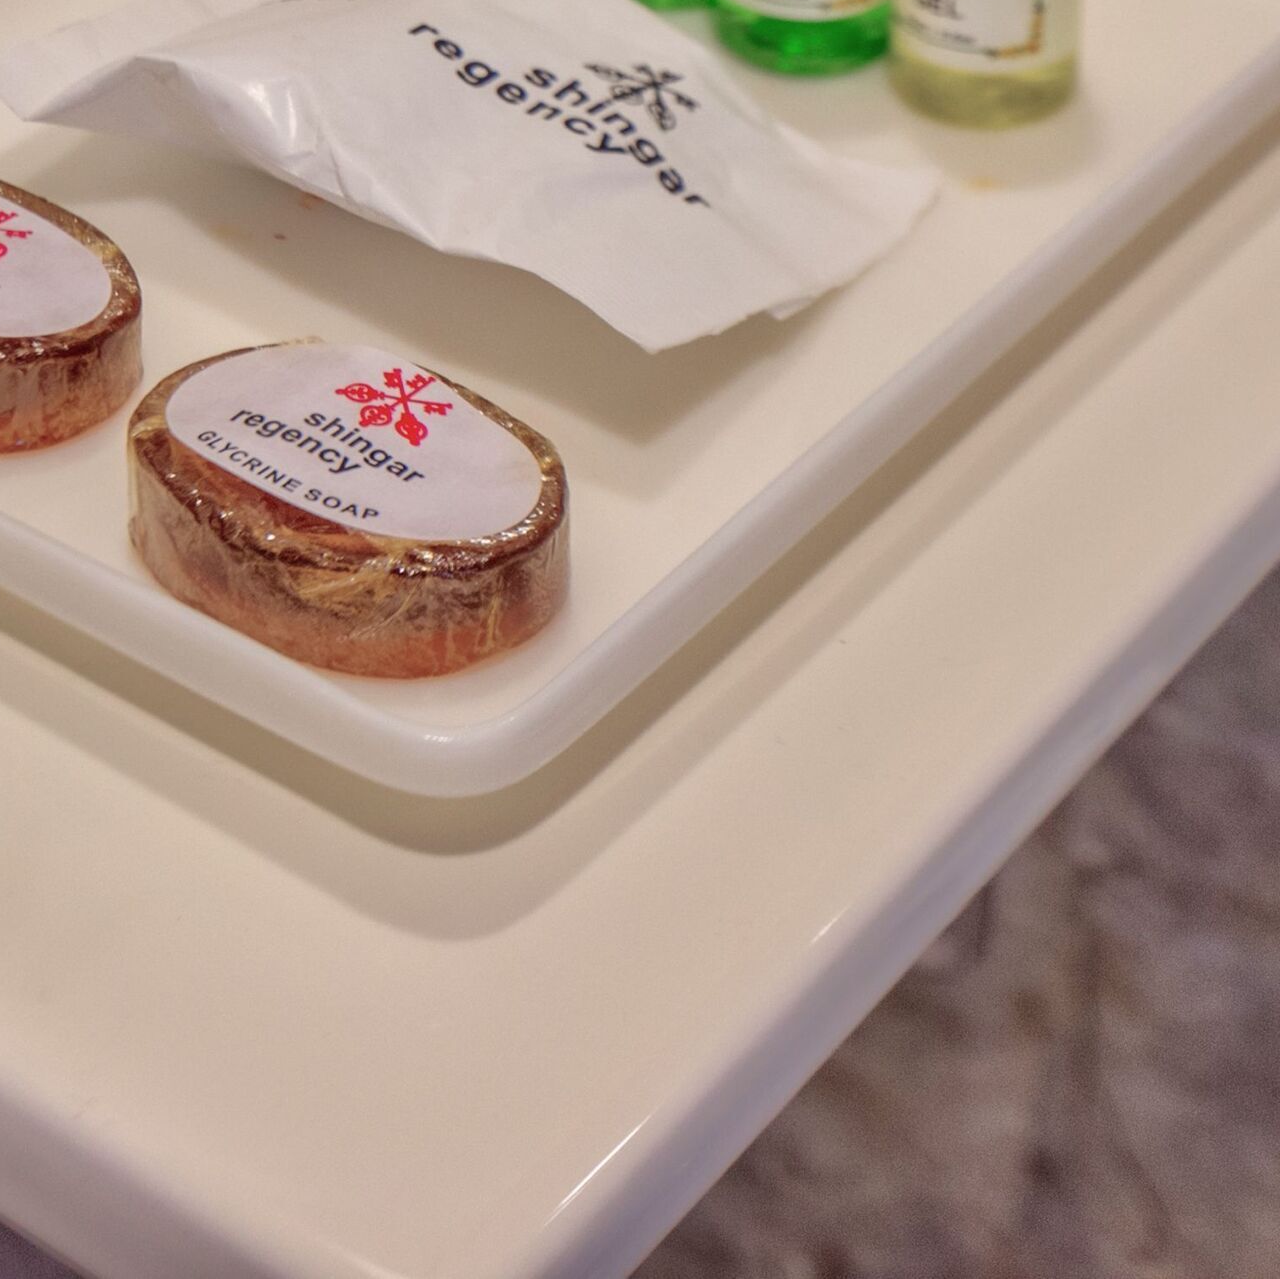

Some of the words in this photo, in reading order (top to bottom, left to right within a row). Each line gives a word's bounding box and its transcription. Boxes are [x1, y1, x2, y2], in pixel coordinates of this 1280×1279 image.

[408, 22, 627, 155] regency
[524, 66, 712, 208] shingar
[197, 430, 300, 493] GLYCRINE
[304, 488, 381, 521] SOAP
[228, 408, 362, 476] regency
[304, 409, 426, 485] shingar
